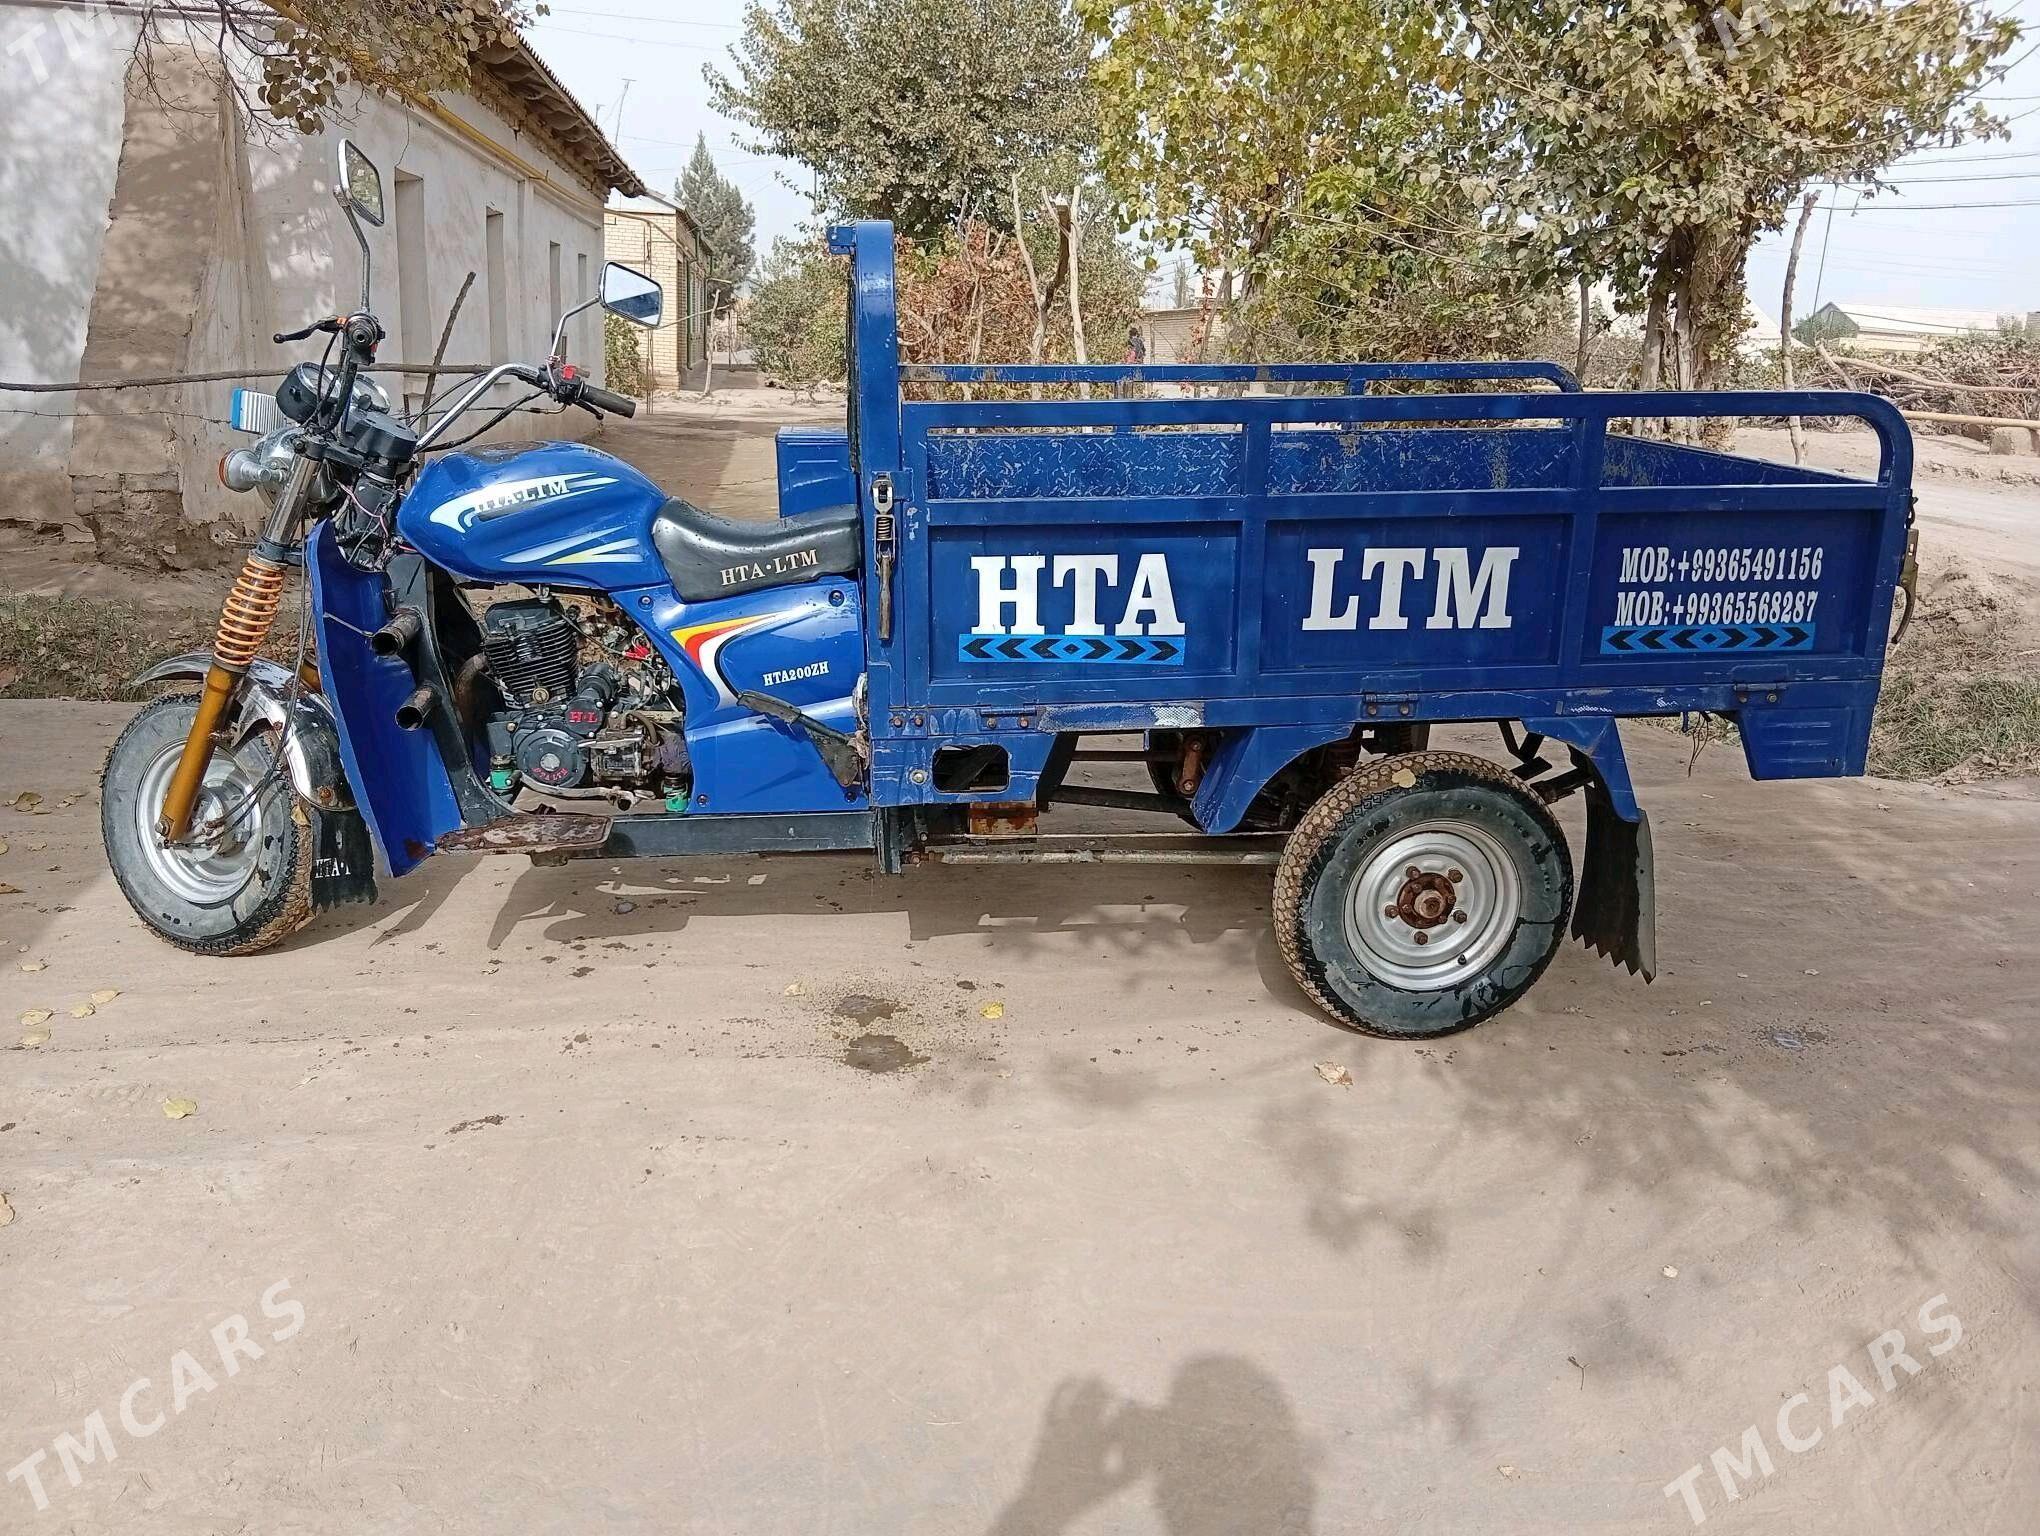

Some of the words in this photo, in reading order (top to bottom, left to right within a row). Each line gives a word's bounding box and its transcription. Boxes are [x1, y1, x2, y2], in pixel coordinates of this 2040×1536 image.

[970, 553, 1186, 636] HTA
[1301, 547, 1520, 631] LTM
[763, 661, 830, 686] HTA200ZH
